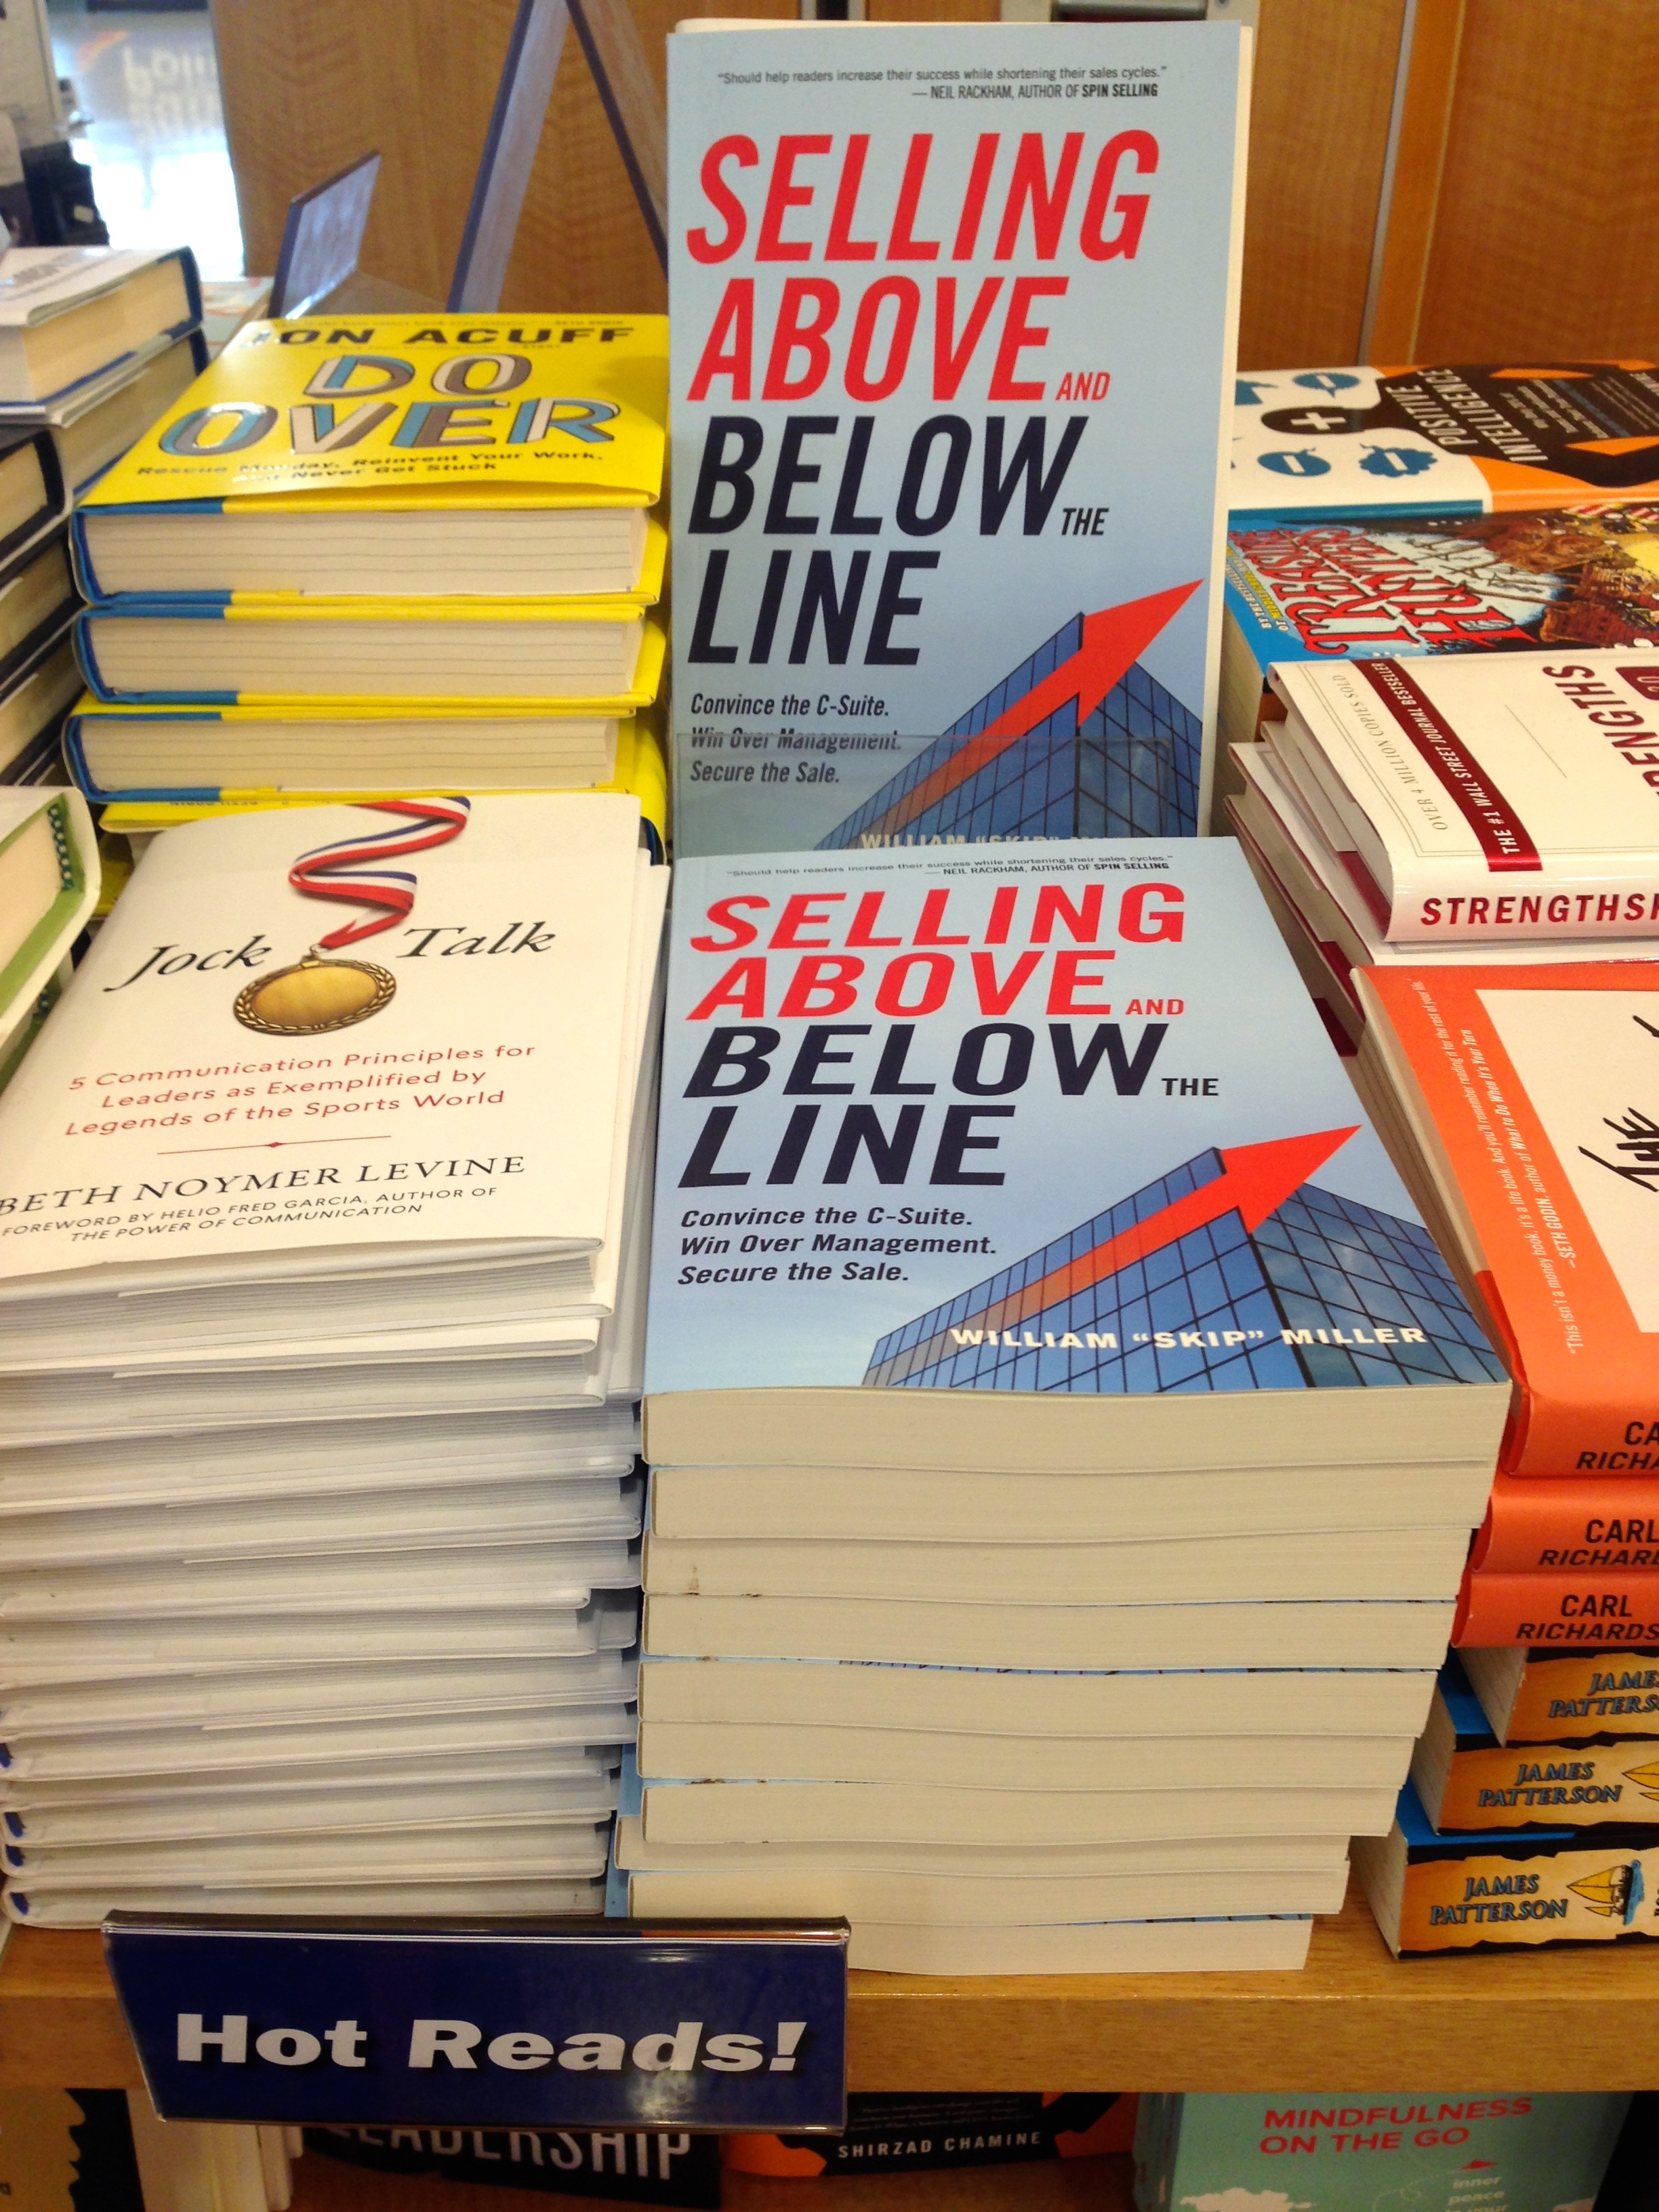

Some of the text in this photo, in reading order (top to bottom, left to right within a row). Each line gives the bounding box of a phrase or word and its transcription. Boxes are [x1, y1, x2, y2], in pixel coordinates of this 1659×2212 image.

[718, 71, 762, 84] “Should
[765, 70, 790, 84] help
[792, 70, 834, 82] readers
[836, 69, 884, 81] increase
[886, 68, 913, 81] their
[916, 69, 960, 81] success
[964, 67, 994, 80] while
[997, 66, 1057, 81] shortening
[1059, 66, 1086, 79] their
[1090, 66, 1118, 79] sales
[958, 83, 1158, 100] RACKHAM, AUTHOR OF SPIN SELLING
[685, 129, 1160, 264] SELLING
[403, 327, 634, 344] ACUFF
[686, 274, 1111, 403] ABOVE AND
[304, 353, 532, 398] DO
[159, 397, 621, 456] OVER
[1385, 384, 1479, 446] POSITIVE
[1416, 368, 1549, 462] INTELLIGENCE
[291, 463, 497, 478] Never Get Stuck
[352, 451, 603, 466] Reinvent Your Work,
[687, 414, 1109, 537] BELOW THE
[1228, 528, 1421, 654] TREASURE
[687, 550, 941, 665] LINE
[691, 693, 889, 716] Convince the C-Suite.
[691, 727, 901, 754] Win Over Management.
[1332, 675, 1448, 830] OVER MILLION COPIES SOLD
[690, 760, 840, 783] Secure the Sale.
[1371, 662, 1520, 855] THE #1 WALL STREET JOURNAL BESTSELLER
[971, 866, 1028, 875] RACKHAM,
[1094, 863, 1121, 871] SPIN
[1124, 862, 1169, 870] SELLING
[1006, 857, 1066, 865] shortening
[689, 882, 1185, 952] SELLING
[102, 920, 557, 993] Jock Talk
[685, 949, 1185, 1021] ABOVE AND
[1428, 1013, 1443, 1026] rest
[1435, 1027, 1450, 1039] the
[1441, 1040, 1455, 1050] for
[68, 1045, 535, 1090] 5 Communication Principles for
[682, 1023, 1219, 1098] BELOW THE
[1449, 1057, 1471, 1084] reading
[101, 1069, 487, 1109] Leaders as Exemplified by
[64, 1090, 505, 1136] Legends of the Sports World
[1462, 1085, 1489, 1123] remember
[1460, 1029, 1563, 1229] GODIN, author of What to Do When Your Turn
[677, 1104, 1016, 1188] LINE
[1486, 1147, 1507, 1164] And
[0, 1156, 525, 1216] BETH NOYMER LEVINE
[1496, 1166, 1518, 1189] book.
[1, 1187, 497, 1237] FOREWORD BY HELIO FRED GARCIA, AUTHOR OF
[1507, 1191, 1525, 1205] life
[71, 1204, 423, 1242] THE POWER OF COMMUNICATION
[680, 1207, 972, 1227] Convince the C-Suite.
[681, 1234, 997, 1256] Win Over Management.
[1523, 1230, 1547, 1256] book,
[678, 1262, 909, 1285] Secure the Sale.
[1538, 1257, 1562, 1288] money
[950, 1327, 1427, 1349] WILLIAM “SKIP” MILLER
[1585, 1519, 1659, 1544] CARL
[1561, 1594, 1633, 1617] CARL
[1514, 1761, 1595, 1786] JAMES
[1477, 1784, 1623, 1808] PATTERSON
[1462, 1874, 1540, 1902] JAMES
[1429, 1898, 1569, 1925] PATTERSON
[176, 2013, 807, 2072] Hot Reads!
[1263, 2096, 1533, 2129] MINDFULNESS
[838, 2131, 1042, 2158] SHIRZAD CHAMINE
[1259, 2126, 1471, 2155] ON THE GO
